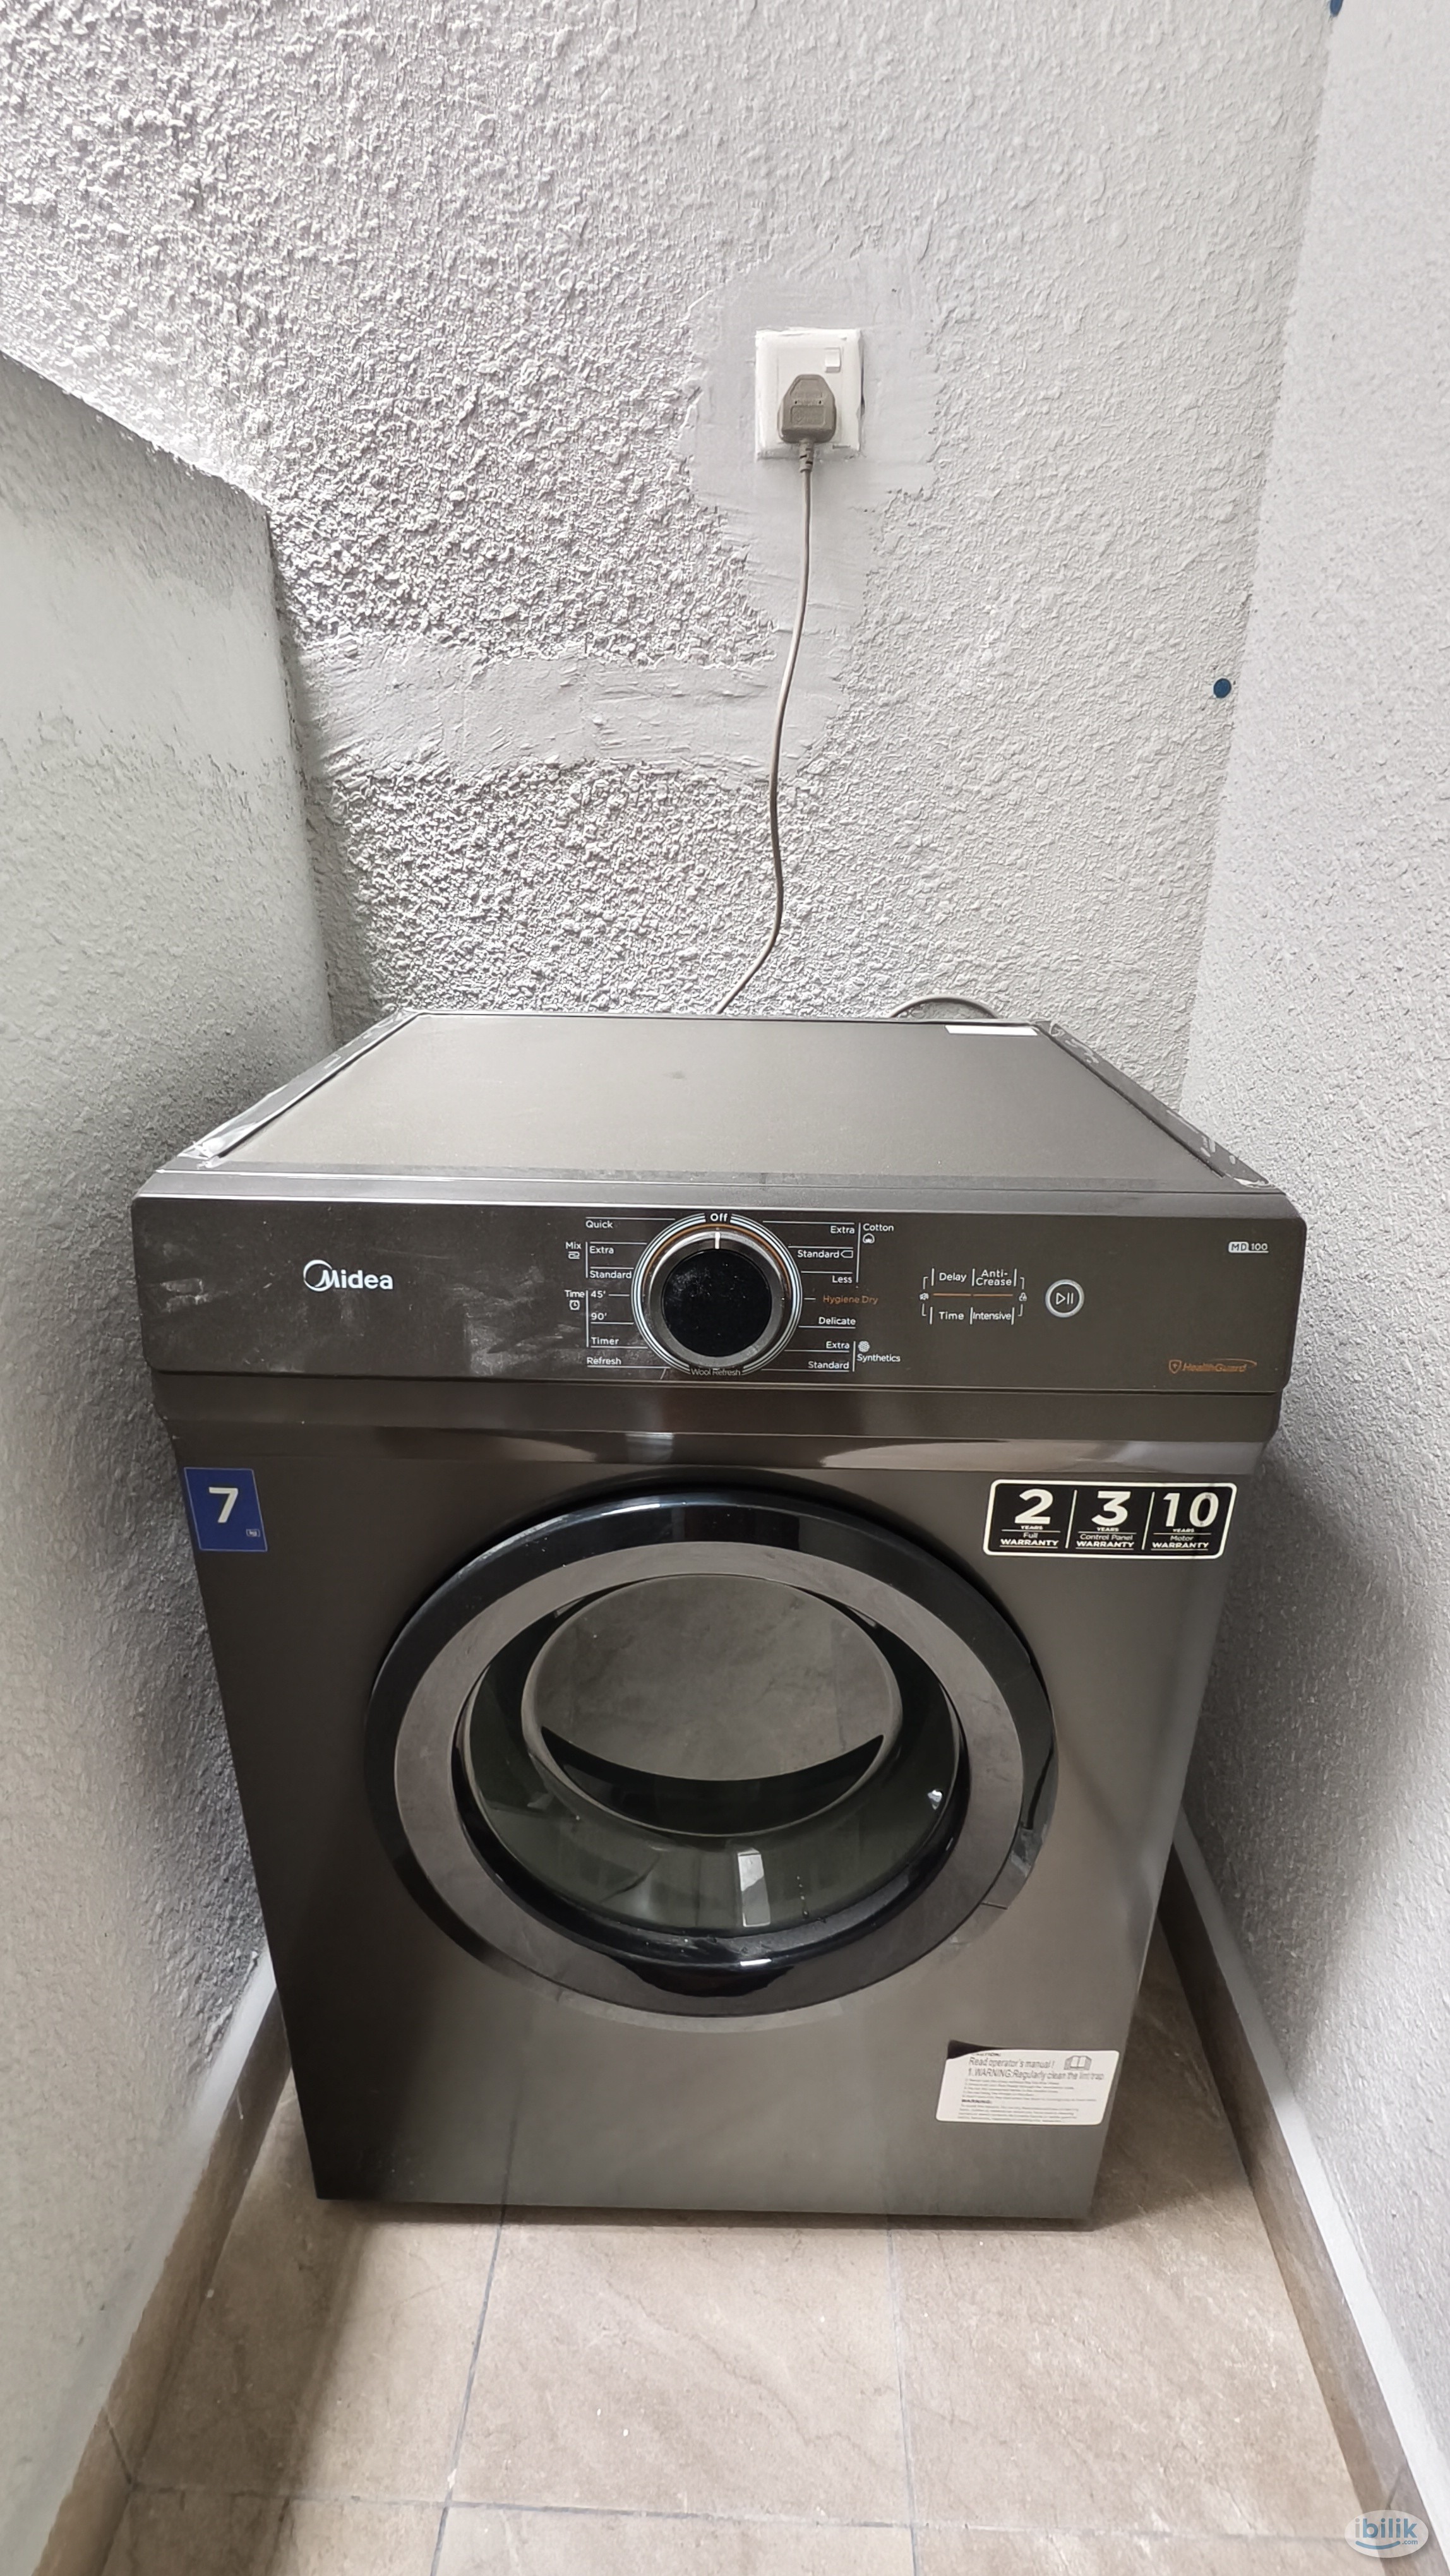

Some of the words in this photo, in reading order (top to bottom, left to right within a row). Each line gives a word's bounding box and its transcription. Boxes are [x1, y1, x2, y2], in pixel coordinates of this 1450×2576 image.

[710, 1213, 728, 1222] Off
[585, 1220, 613, 1229] Quick
[863, 1223, 894, 1231] Cotton
[830, 1225, 855, 1234] Extra
[589, 1246, 614, 1255] Extra
[1251, 1243, 1268, 1251] 100
[797, 1249, 840, 1258] Standard
[303, 1260, 394, 1292] Midea
[589, 1270, 632, 1279] Standard
[938, 1272, 967, 1282] Delay
[981, 1269, 1008, 1278] Anti-
[832, 1275, 853, 1284] Less
[976, 1277, 1012, 1286] Crease
[564, 1289, 585, 1298] Time
[823, 1295, 860, 1304] Hygiene
[861, 1296, 878, 1305] Dry
[938, 1311, 964, 1320] Time
[973, 1311, 1012, 1320] Intensive
[818, 1316, 856, 1325] Delicate
[590, 1336, 619, 1345] Timer
[825, 1340, 850, 1349] Extra
[587, 1357, 622, 1365] Refresh
[856, 1353, 901, 1363] Synthetics
[808, 1361, 849, 1369] Standard
[691, 1368, 710, 1376] Wool
[712, 1368, 741, 1376] Refresh
[208, 1486, 239, 1524] 7
[1014, 1489, 1053, 1525] 2
[1091, 1491, 1132, 1527] 3
[1163, 1492, 1219, 1528] 10
[969, 2056, 988, 2066] Read
